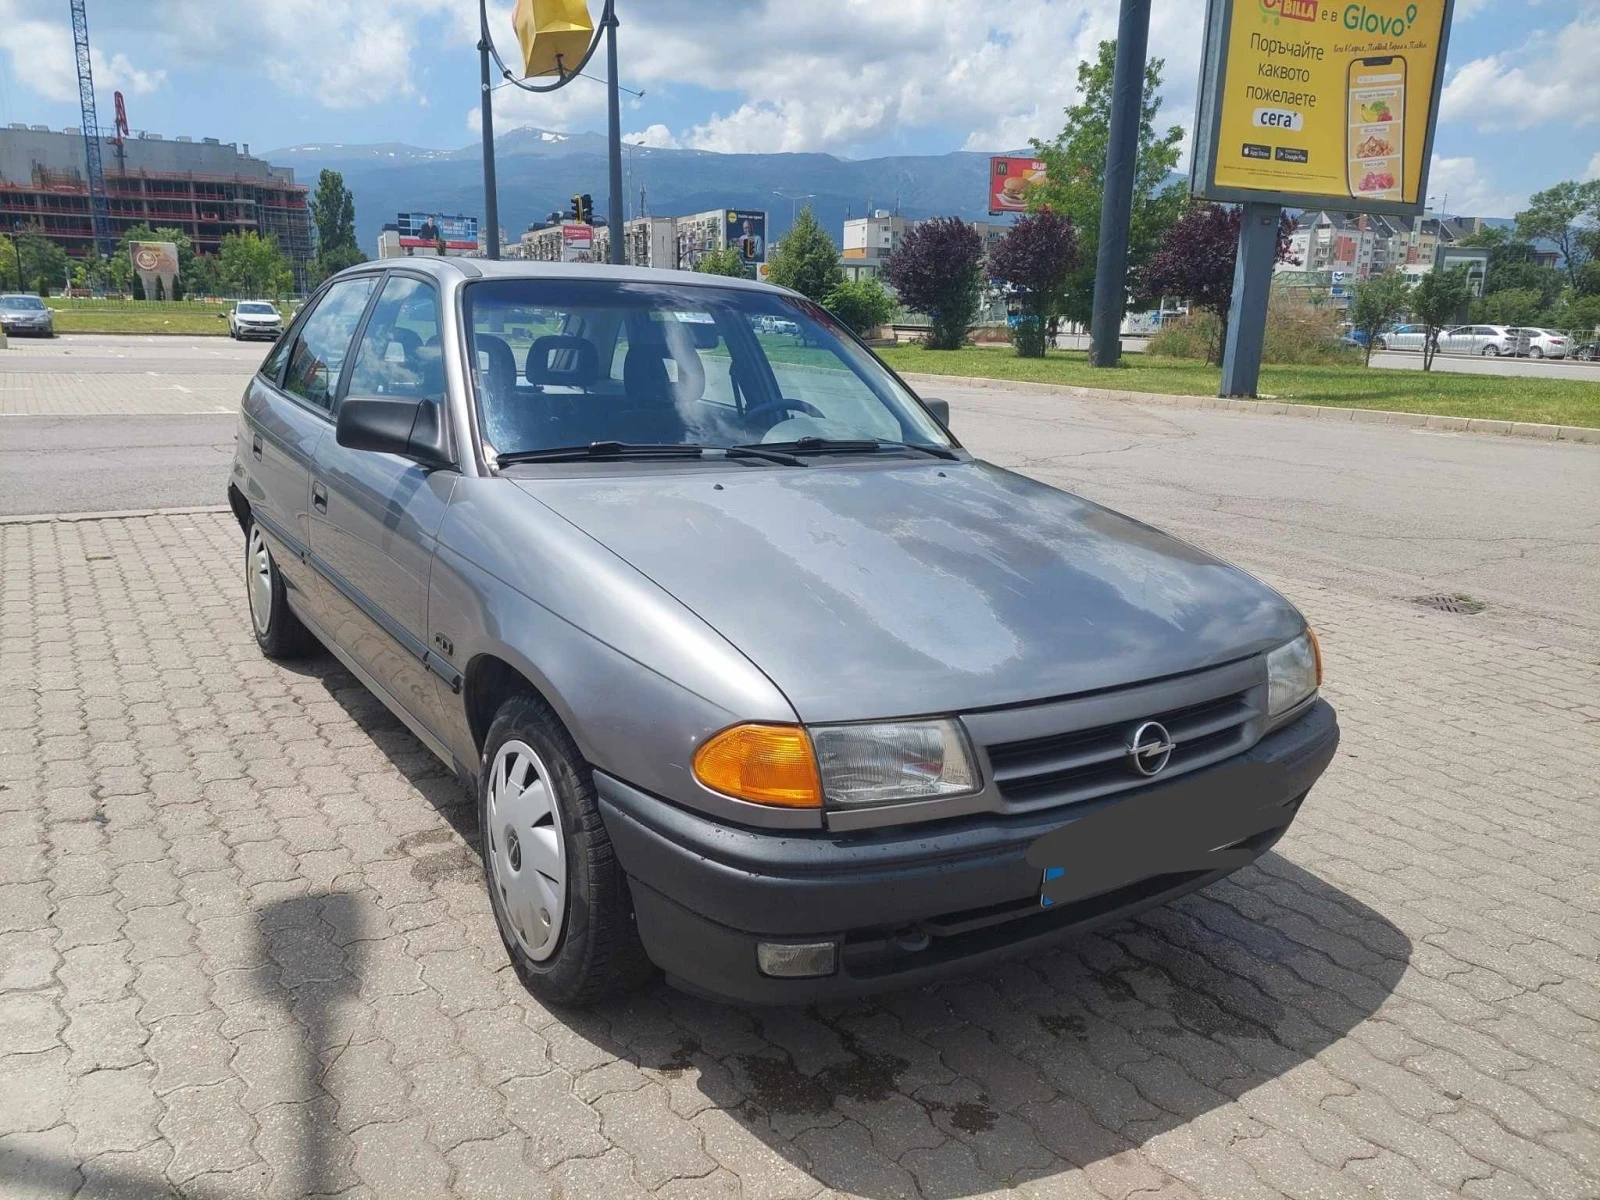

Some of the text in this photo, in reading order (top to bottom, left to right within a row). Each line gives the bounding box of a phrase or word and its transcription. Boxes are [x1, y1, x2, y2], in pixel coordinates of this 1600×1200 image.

[1283, 0, 1314, 19] BILLA
[1321, 9, 1338, 22] е в
[1343, 4, 1405, 37] Glovo
[1250, 32, 1324, 61] Поръчайте
[1258, 62, 1310, 83] каквото
[1246, 85, 1317, 108] пожелаете
